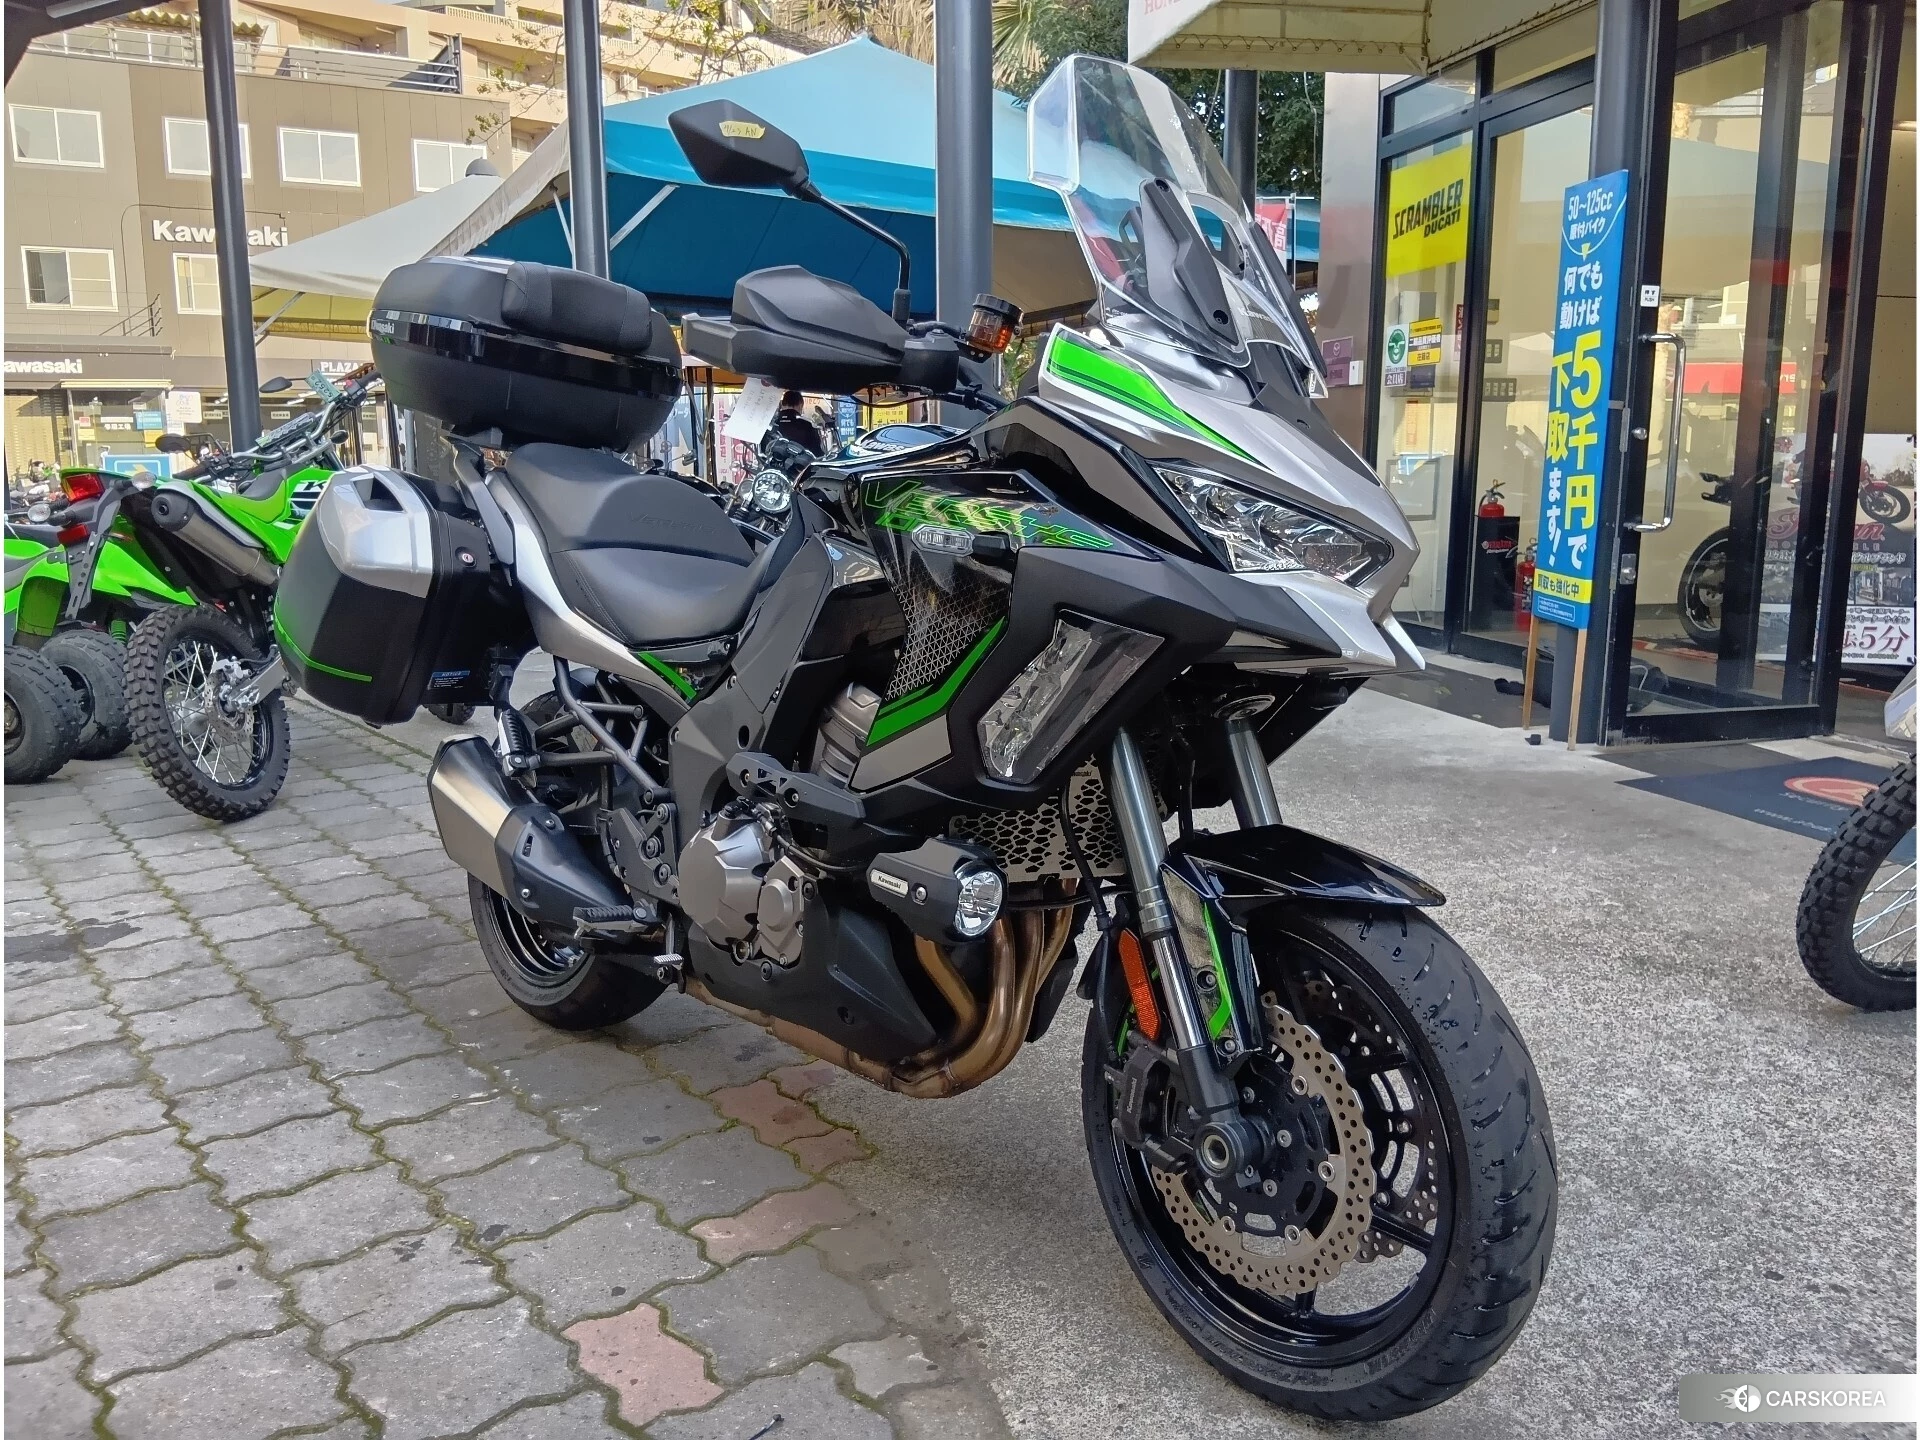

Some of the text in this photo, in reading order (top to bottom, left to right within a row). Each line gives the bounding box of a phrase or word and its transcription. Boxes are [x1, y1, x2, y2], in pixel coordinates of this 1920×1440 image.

[1393, 179, 1463, 240] SCRAMBLER
[1424, 208, 1461, 238] DUCATI
[153, 219, 289, 247] Kawaki
[1569, 216, 1606, 240] 原付バイク
[1564, 261, 1603, 296] 何でも
[1559, 296, 1603, 330] 動けば
[4, 359, 83, 374] awasaki
[877, 875, 902, 889] Kawasaki
